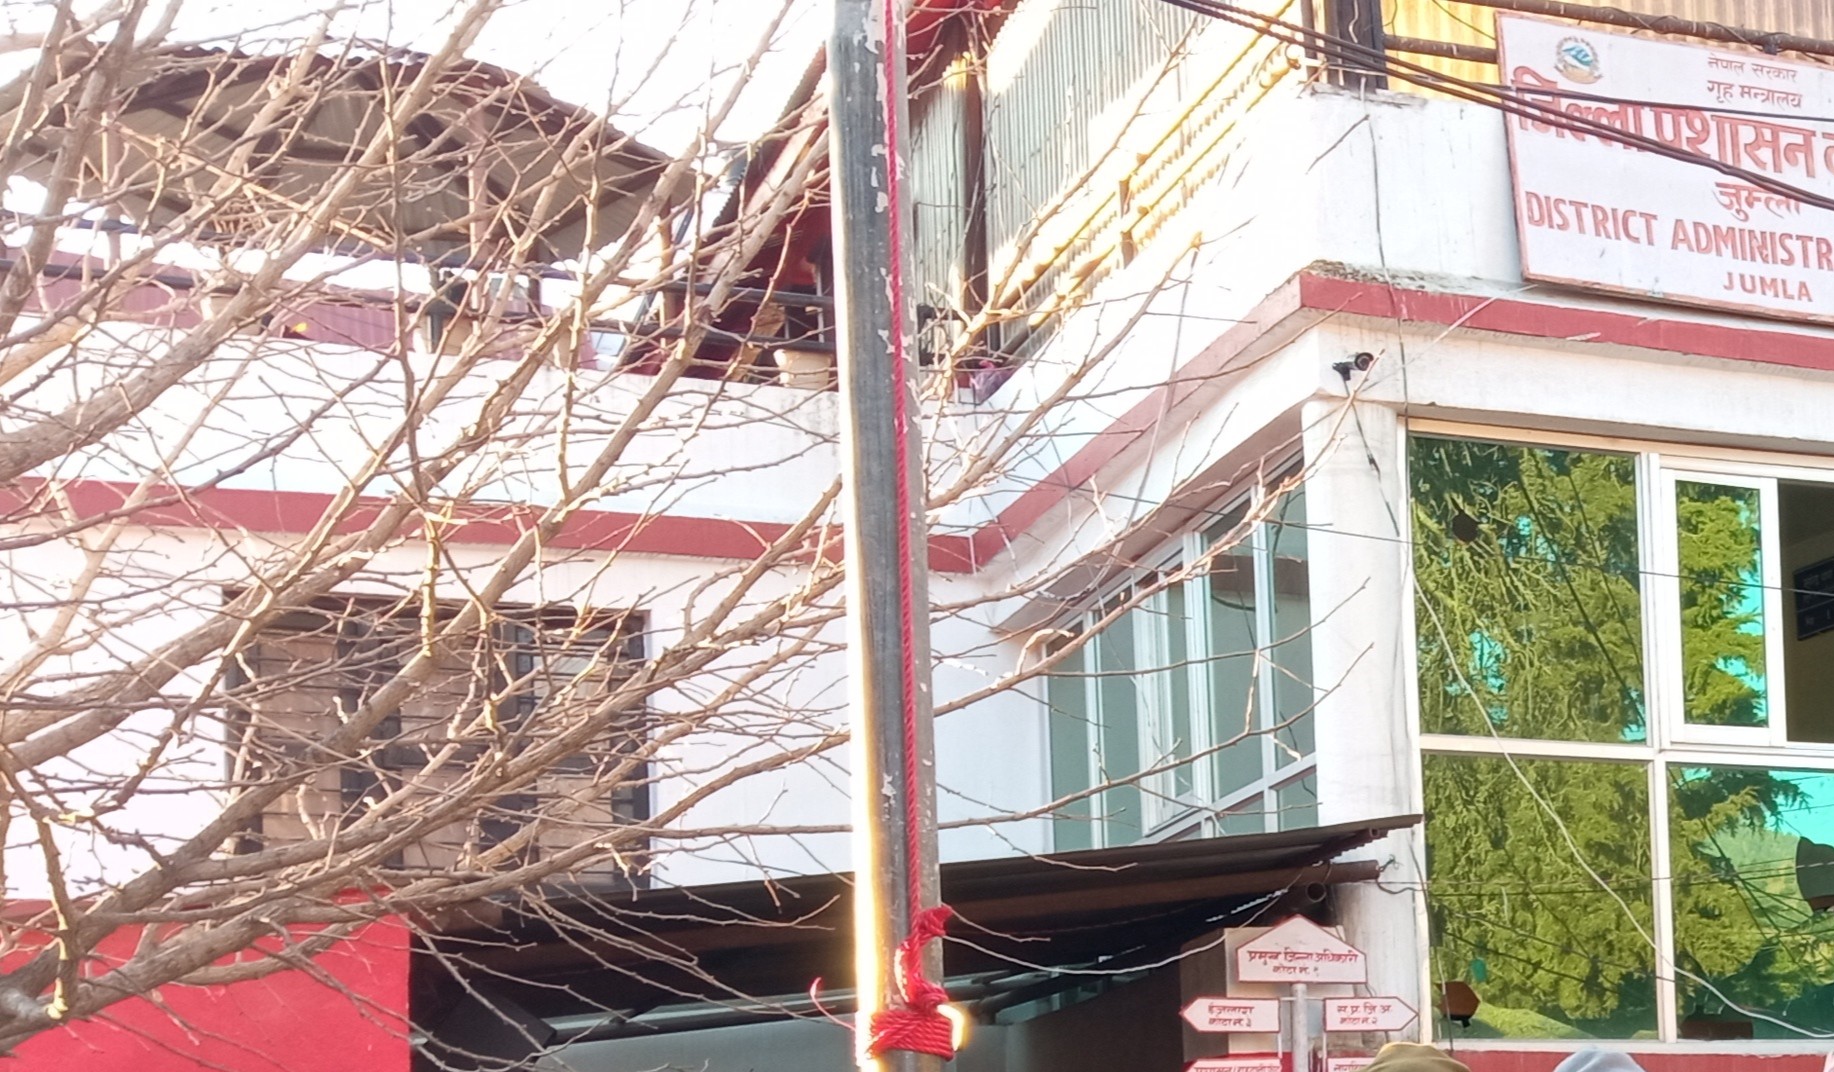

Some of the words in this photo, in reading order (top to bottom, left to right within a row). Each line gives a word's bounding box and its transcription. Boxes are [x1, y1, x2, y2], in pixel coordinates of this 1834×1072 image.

[1708, 52, 1745, 77] नेपाल
[1751, 62, 1798, 82] सरकार
[1707, 79, 1734, 104] गृह
[1712, 181, 1801, 222] जुम्ला
[1524, 190, 1658, 247] DISTRICT
[1723, 271, 1814, 303] JUMLA
